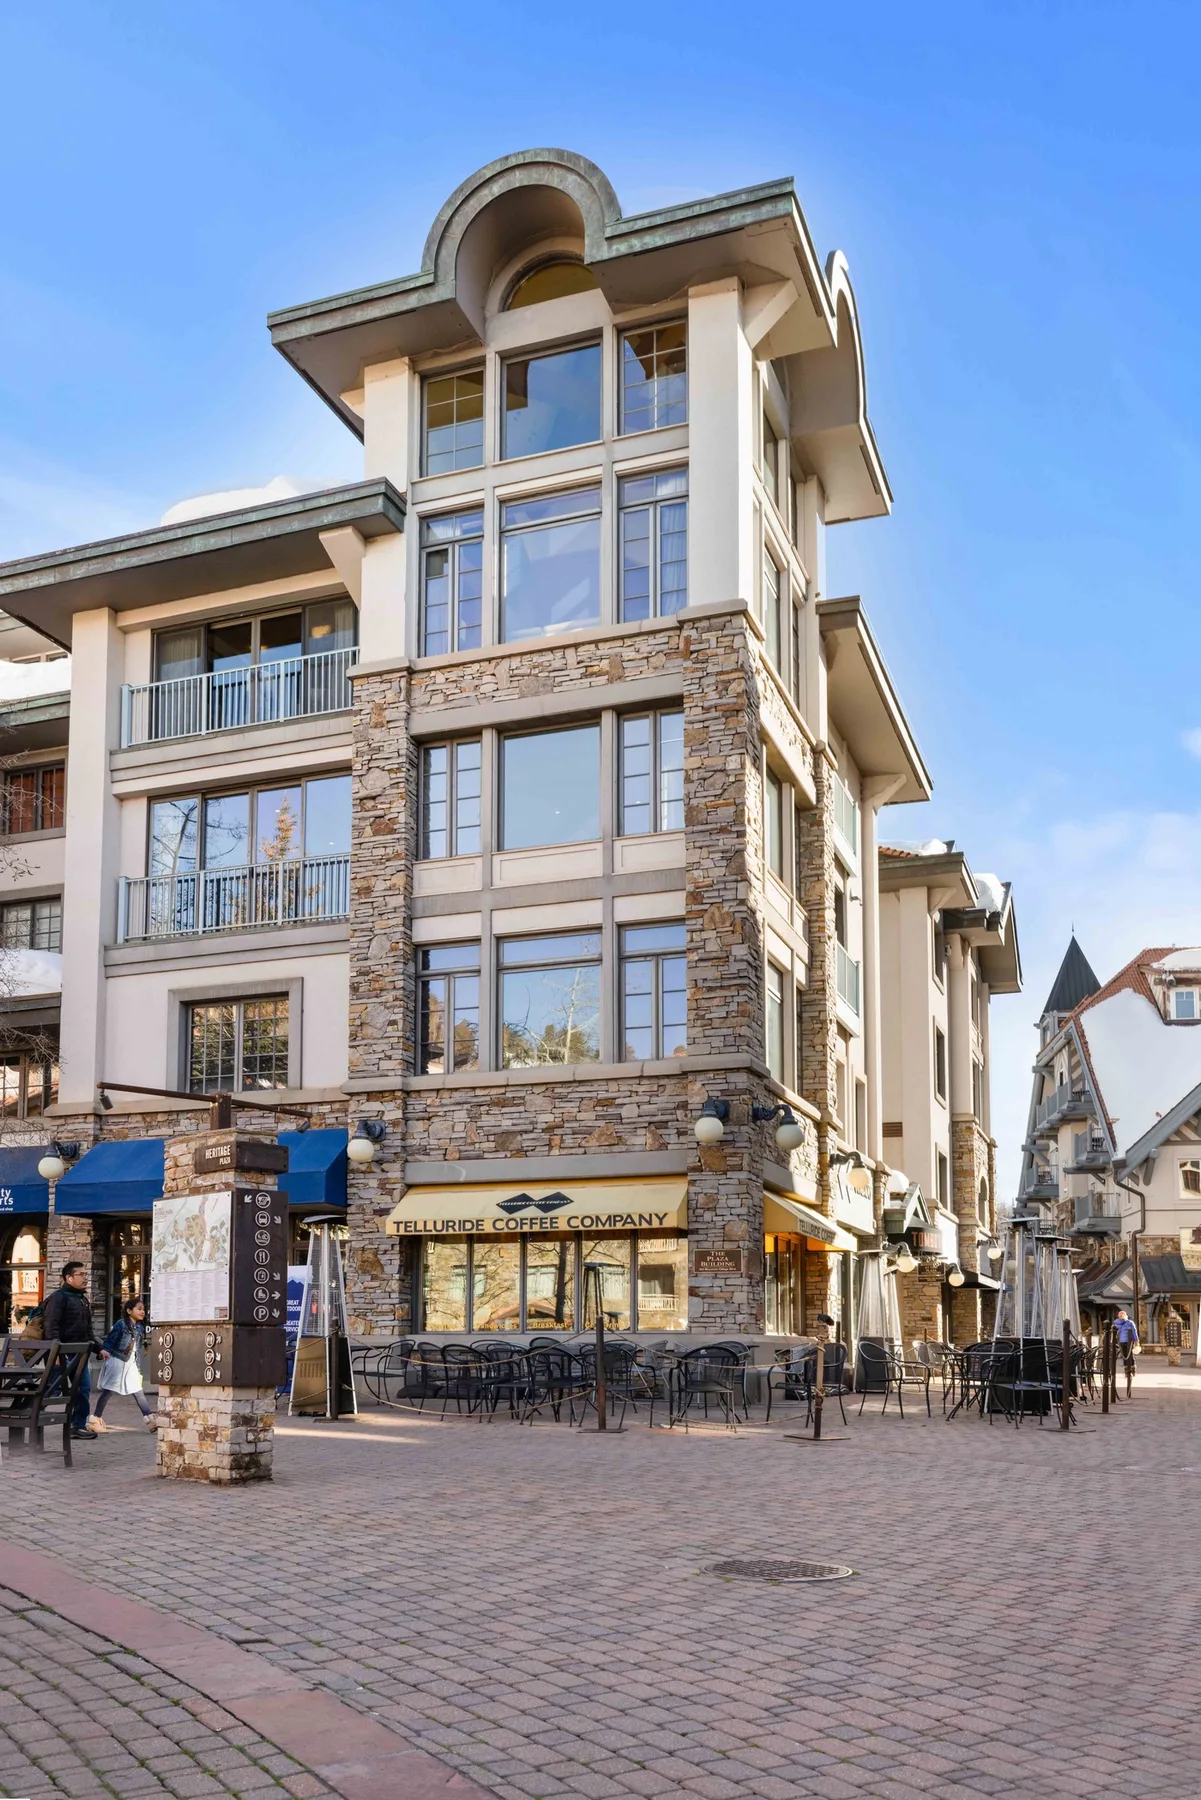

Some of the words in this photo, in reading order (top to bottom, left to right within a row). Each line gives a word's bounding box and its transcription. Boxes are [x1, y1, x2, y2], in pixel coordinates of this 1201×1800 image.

[205, 1145, 231, 1159] HERITAGE
[219, 1157, 231, 1165] PLAZA
[1, 1188, 11, 1200] ty
[0, 1196, 14, 1205] rts
[393, 1219, 485, 1233] TELLURIDE
[492, 1216, 559, 1231] COFFEE
[567, 1212, 668, 1229] COMPANY
